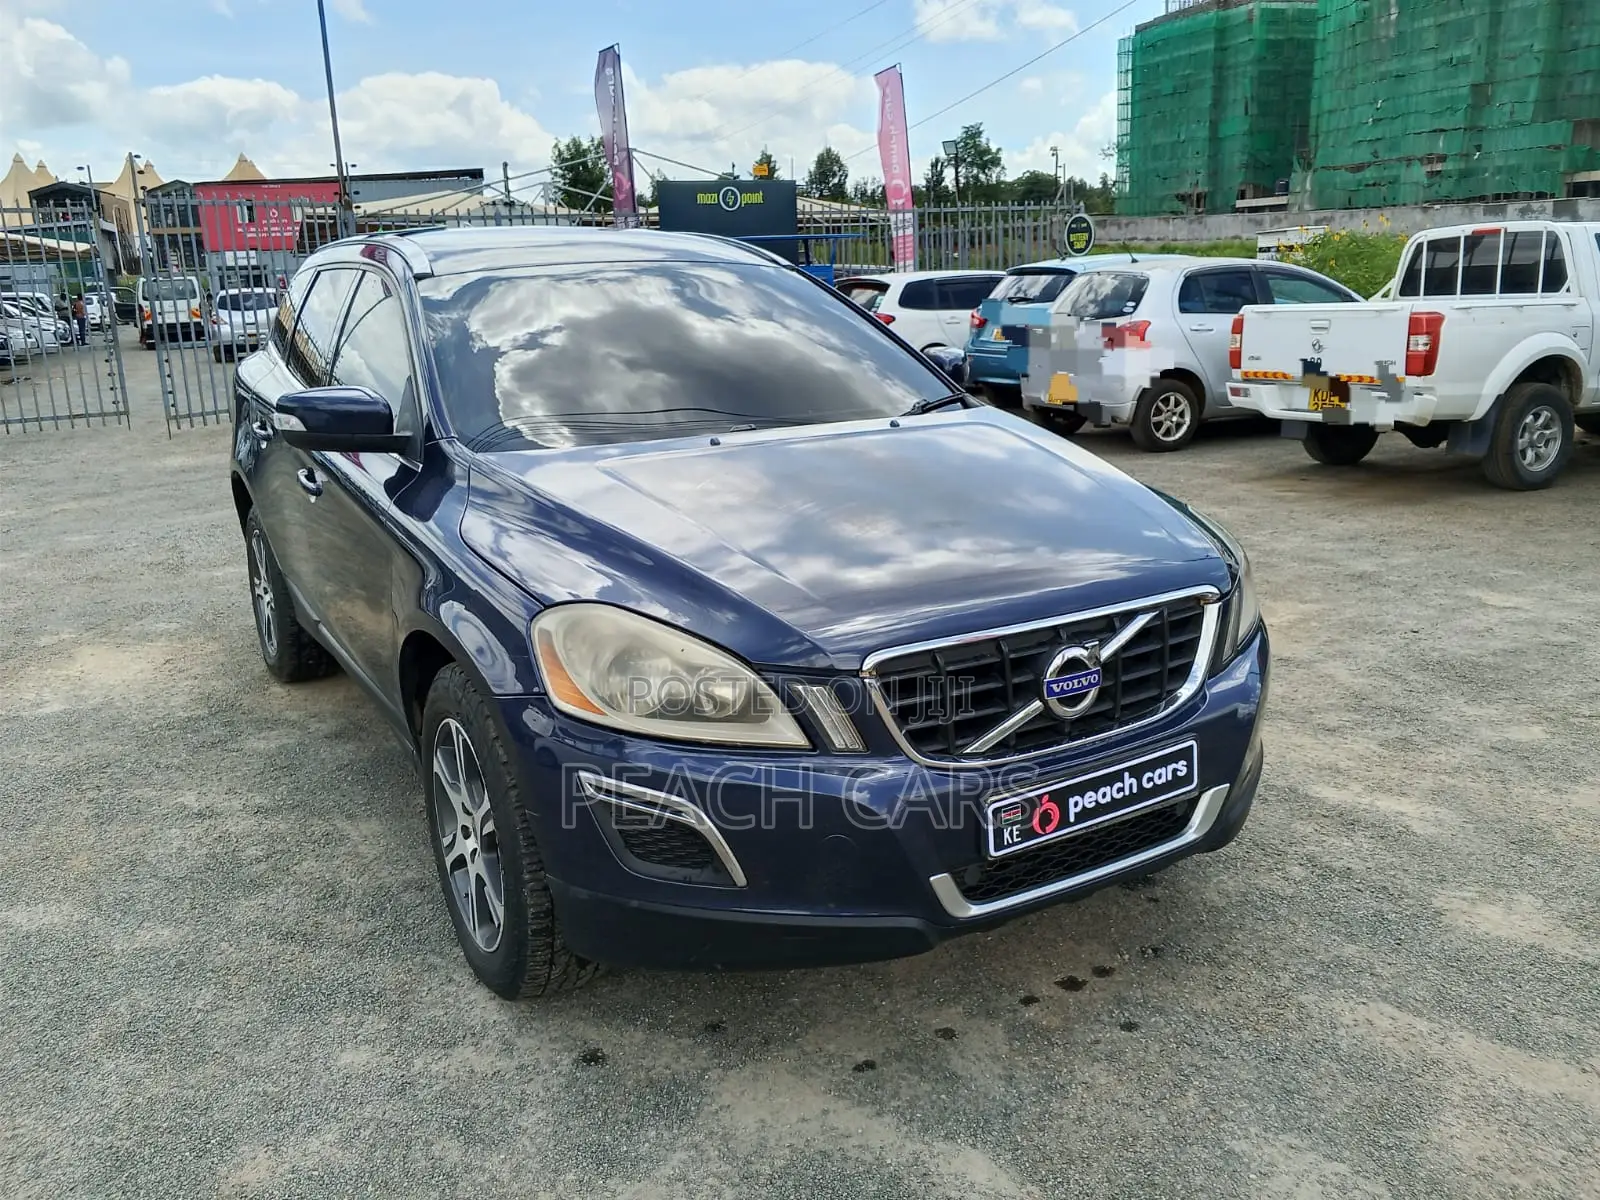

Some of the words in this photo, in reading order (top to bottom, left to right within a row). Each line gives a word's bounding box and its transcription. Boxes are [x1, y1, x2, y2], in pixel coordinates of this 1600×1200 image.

[741, 190, 764, 207] point
[1050, 674, 1099, 693] VOLVO
[1068, 771, 1138, 823] peach
[1141, 759, 1188, 789] cars
[1003, 824, 1022, 846] KE
